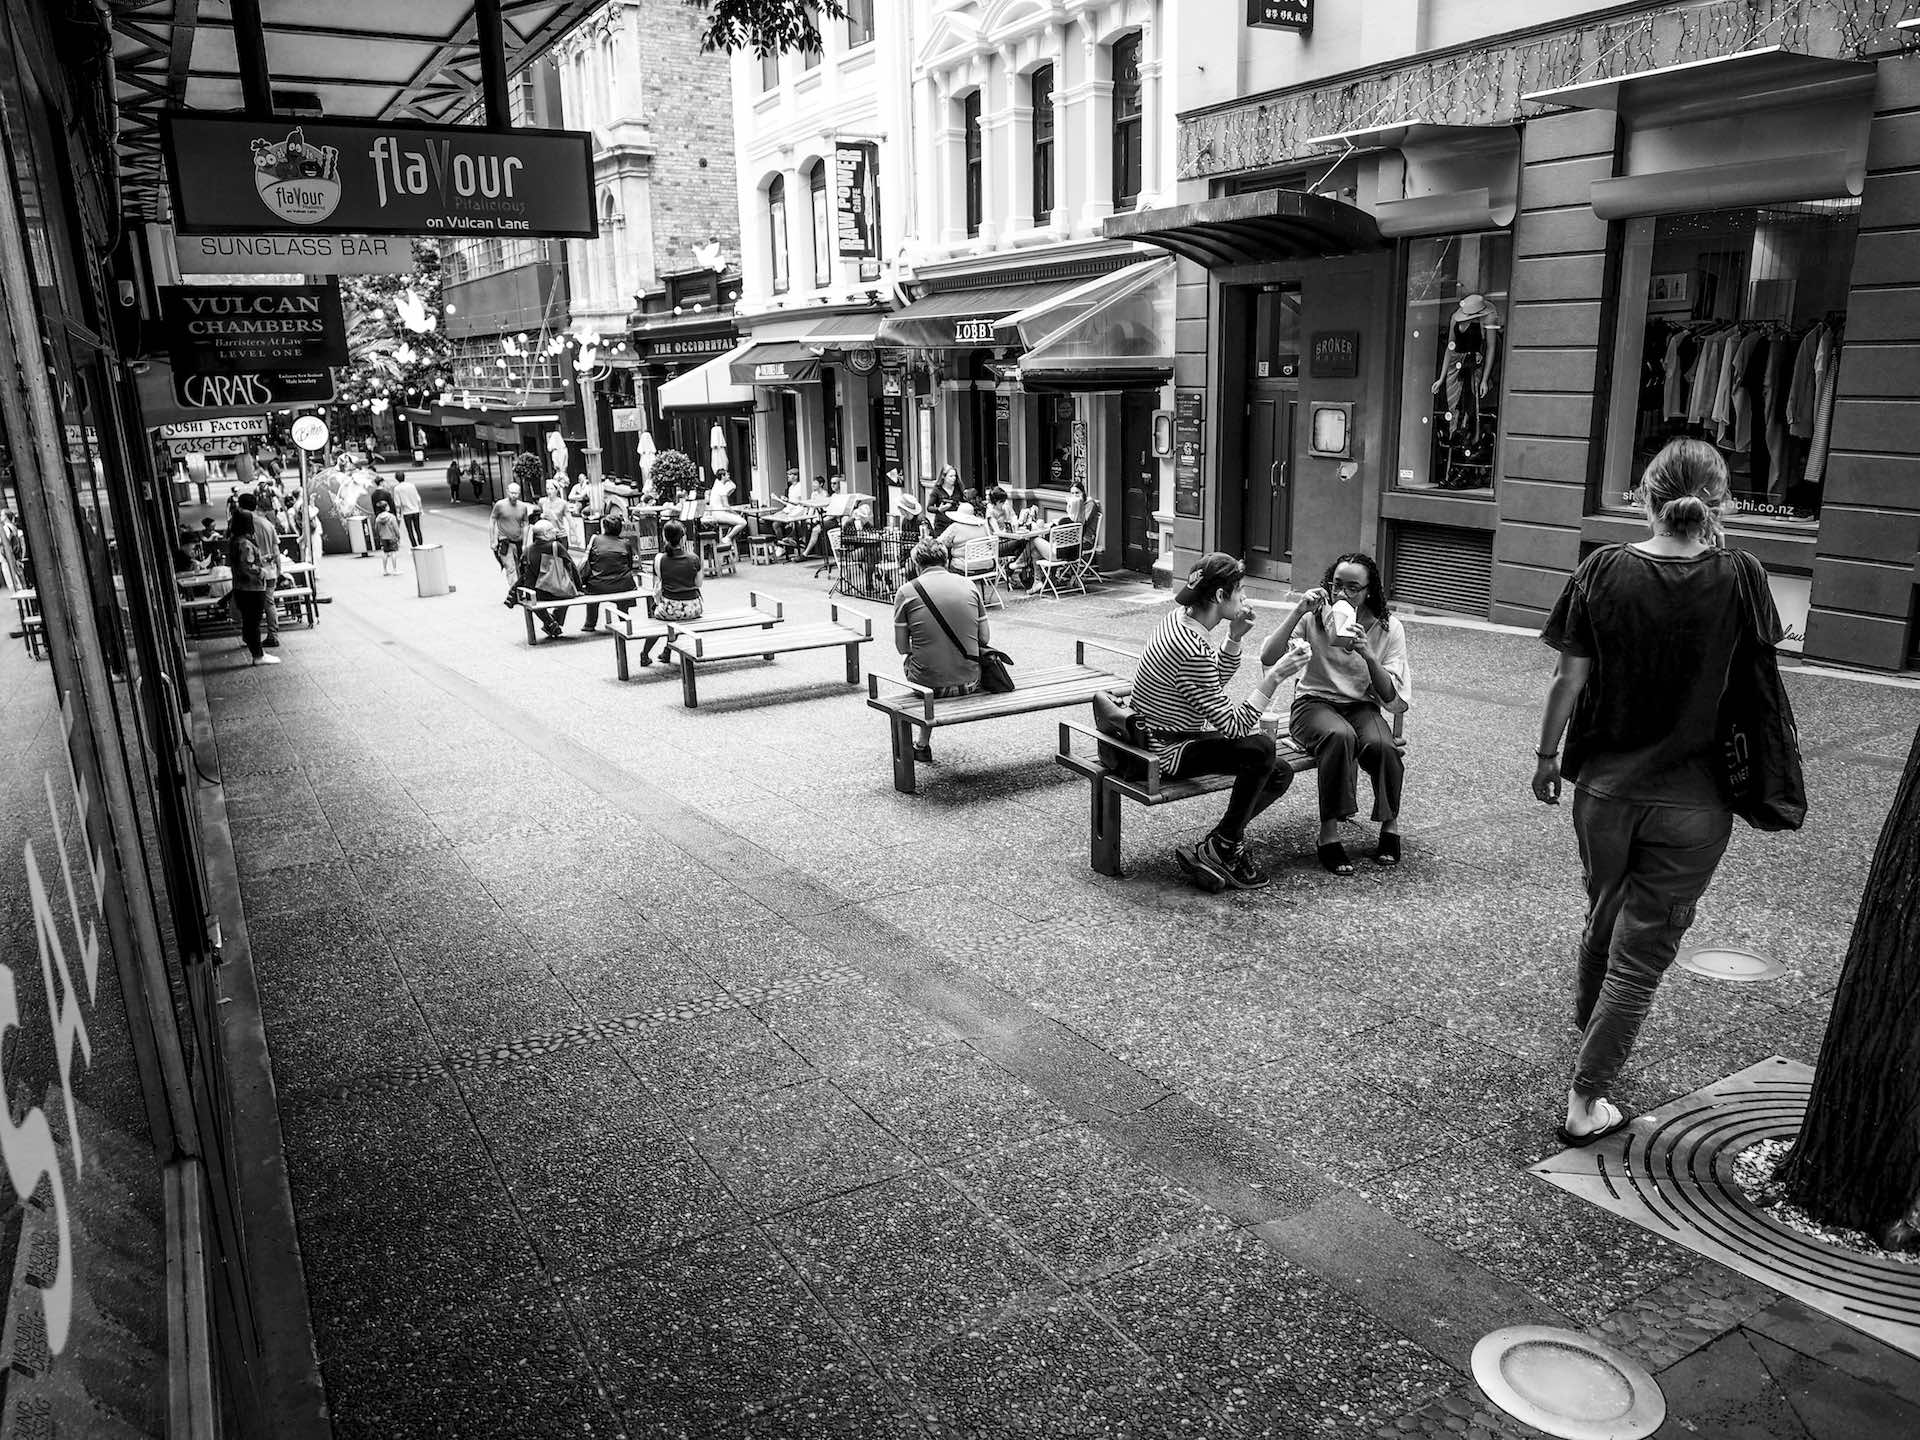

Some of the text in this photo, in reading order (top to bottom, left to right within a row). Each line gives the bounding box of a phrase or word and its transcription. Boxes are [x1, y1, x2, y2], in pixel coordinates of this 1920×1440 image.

[836, 149, 865, 250] RAW POWER
[851, 187, 861, 213] CAFE
[426, 216, 529, 229] on Vulcan Lane
[201, 237, 388, 255] SUNGLASS BAR
[182, 296, 320, 314] VULCAN
[188, 319, 323, 334] CHAMBERS
[955, 323, 994, 339] LOBBY
[215, 338, 302, 347] Barristers At Law
[654, 338, 735, 354] THE OCCIDENTAL
[1315, 337, 1352, 355] BROKER
[220, 349, 302, 358] LEVEL ONE
[184, 374, 272, 407] CARATS
[165, 419, 263, 436] SUSHI FACTORY
